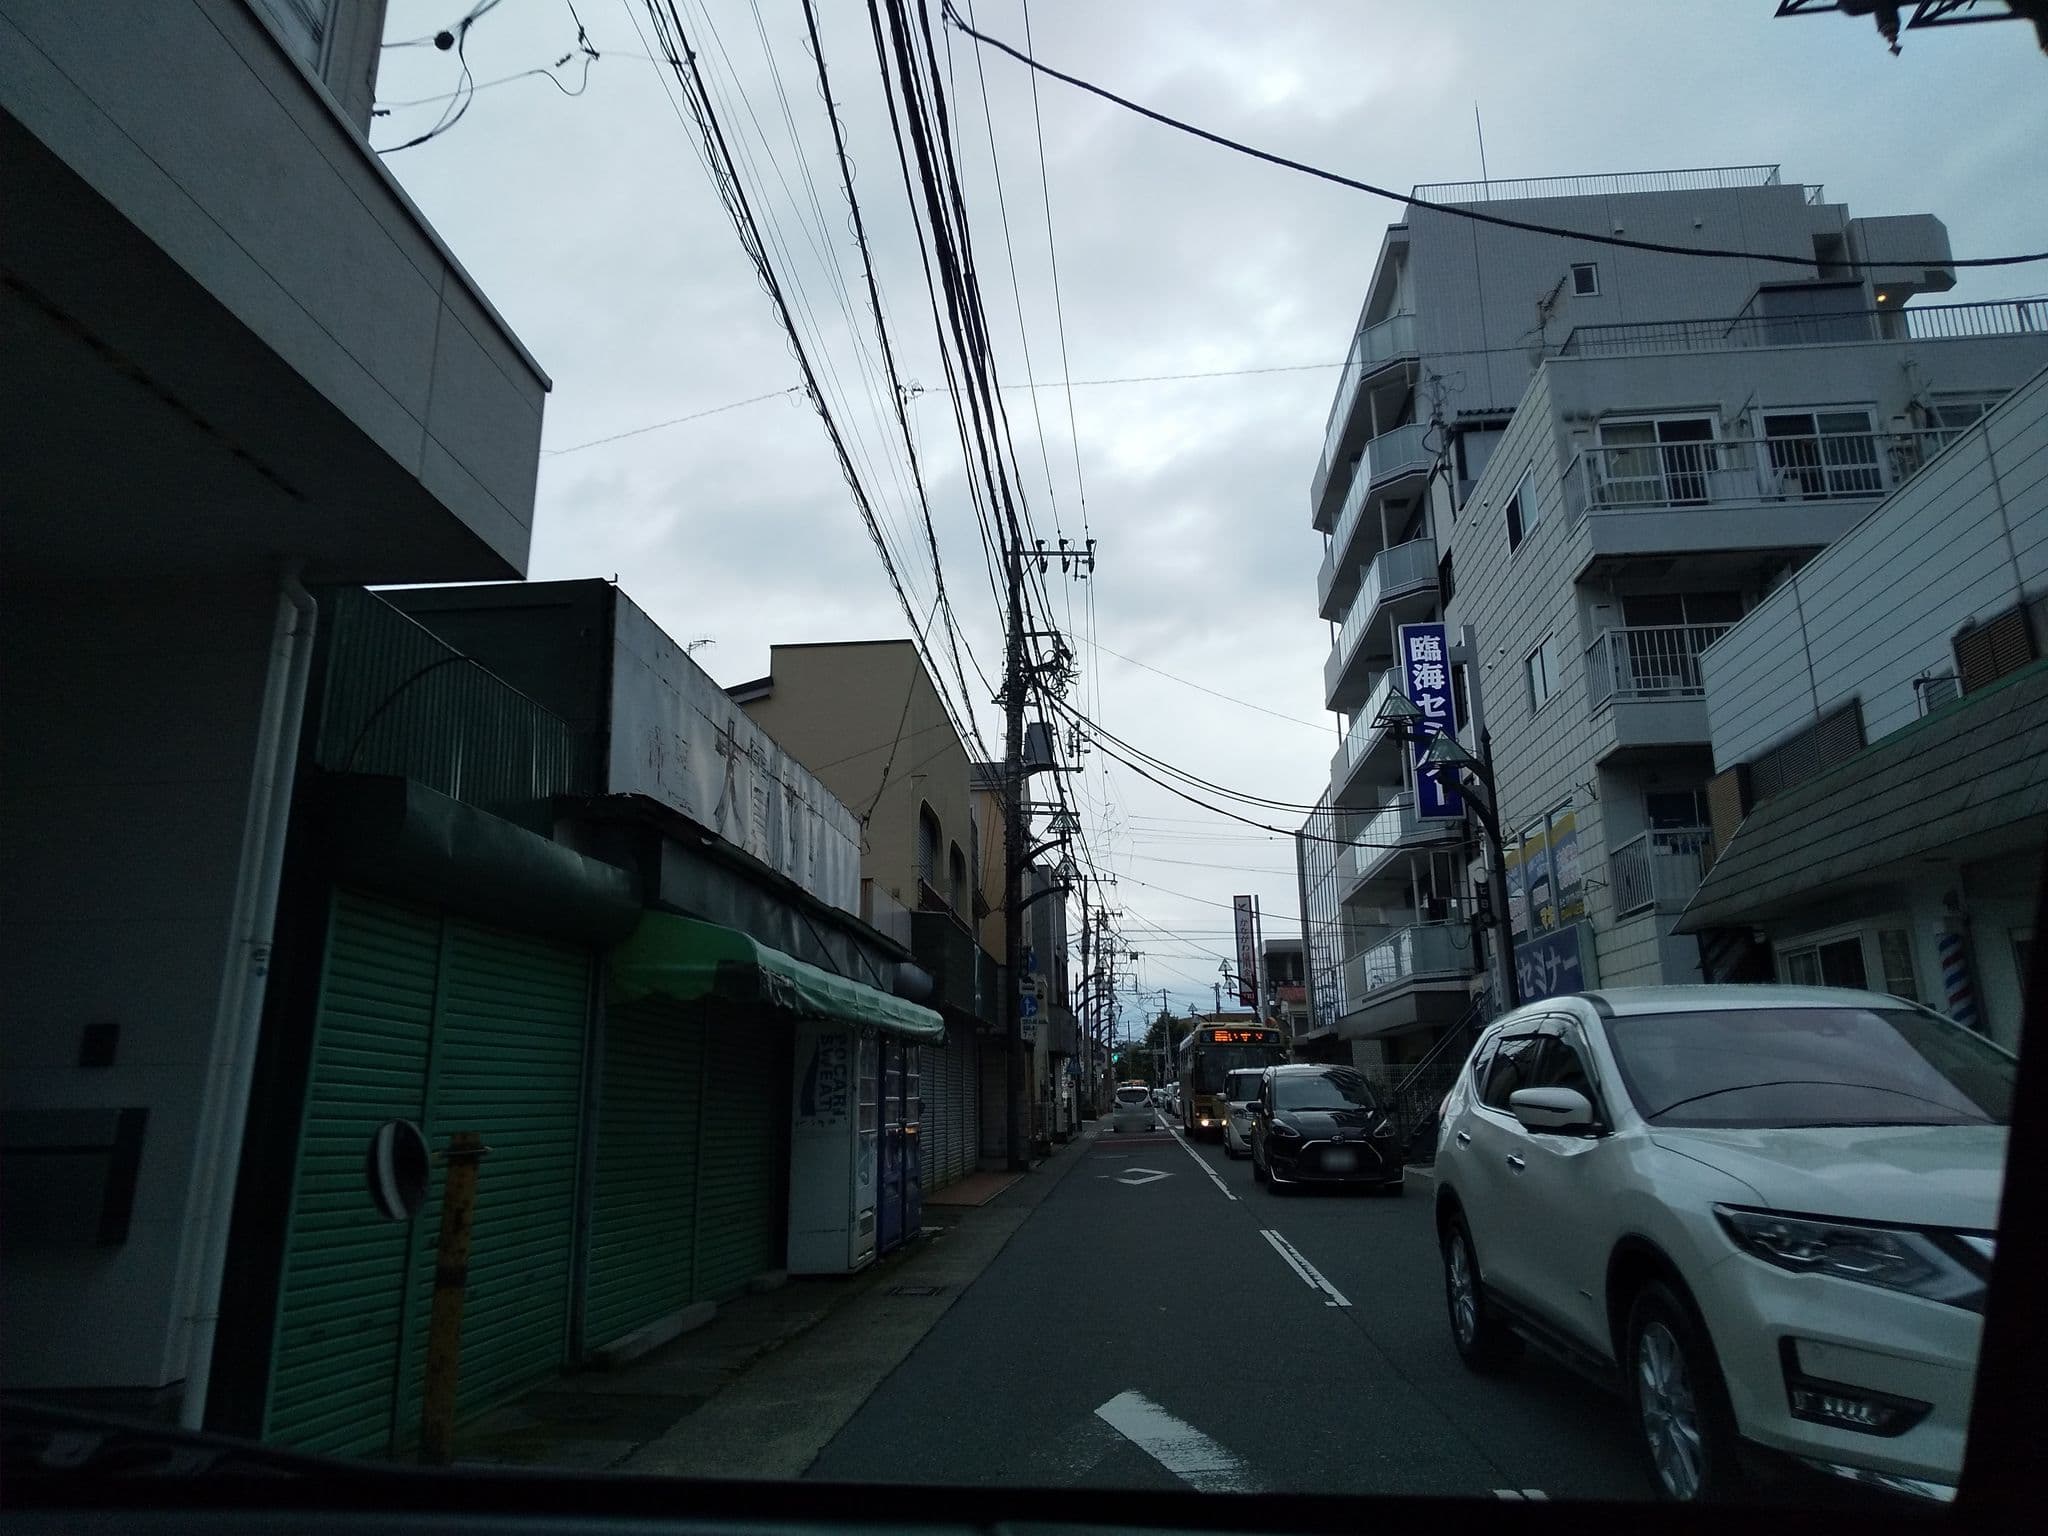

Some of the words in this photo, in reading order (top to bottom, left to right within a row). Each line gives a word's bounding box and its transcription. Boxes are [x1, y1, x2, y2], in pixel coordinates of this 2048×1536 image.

[1518, 945, 1579, 998] セミナー
[818, 1033, 833, 1113] SWEAT
[832, 1033, 847, 1116] POCARI
